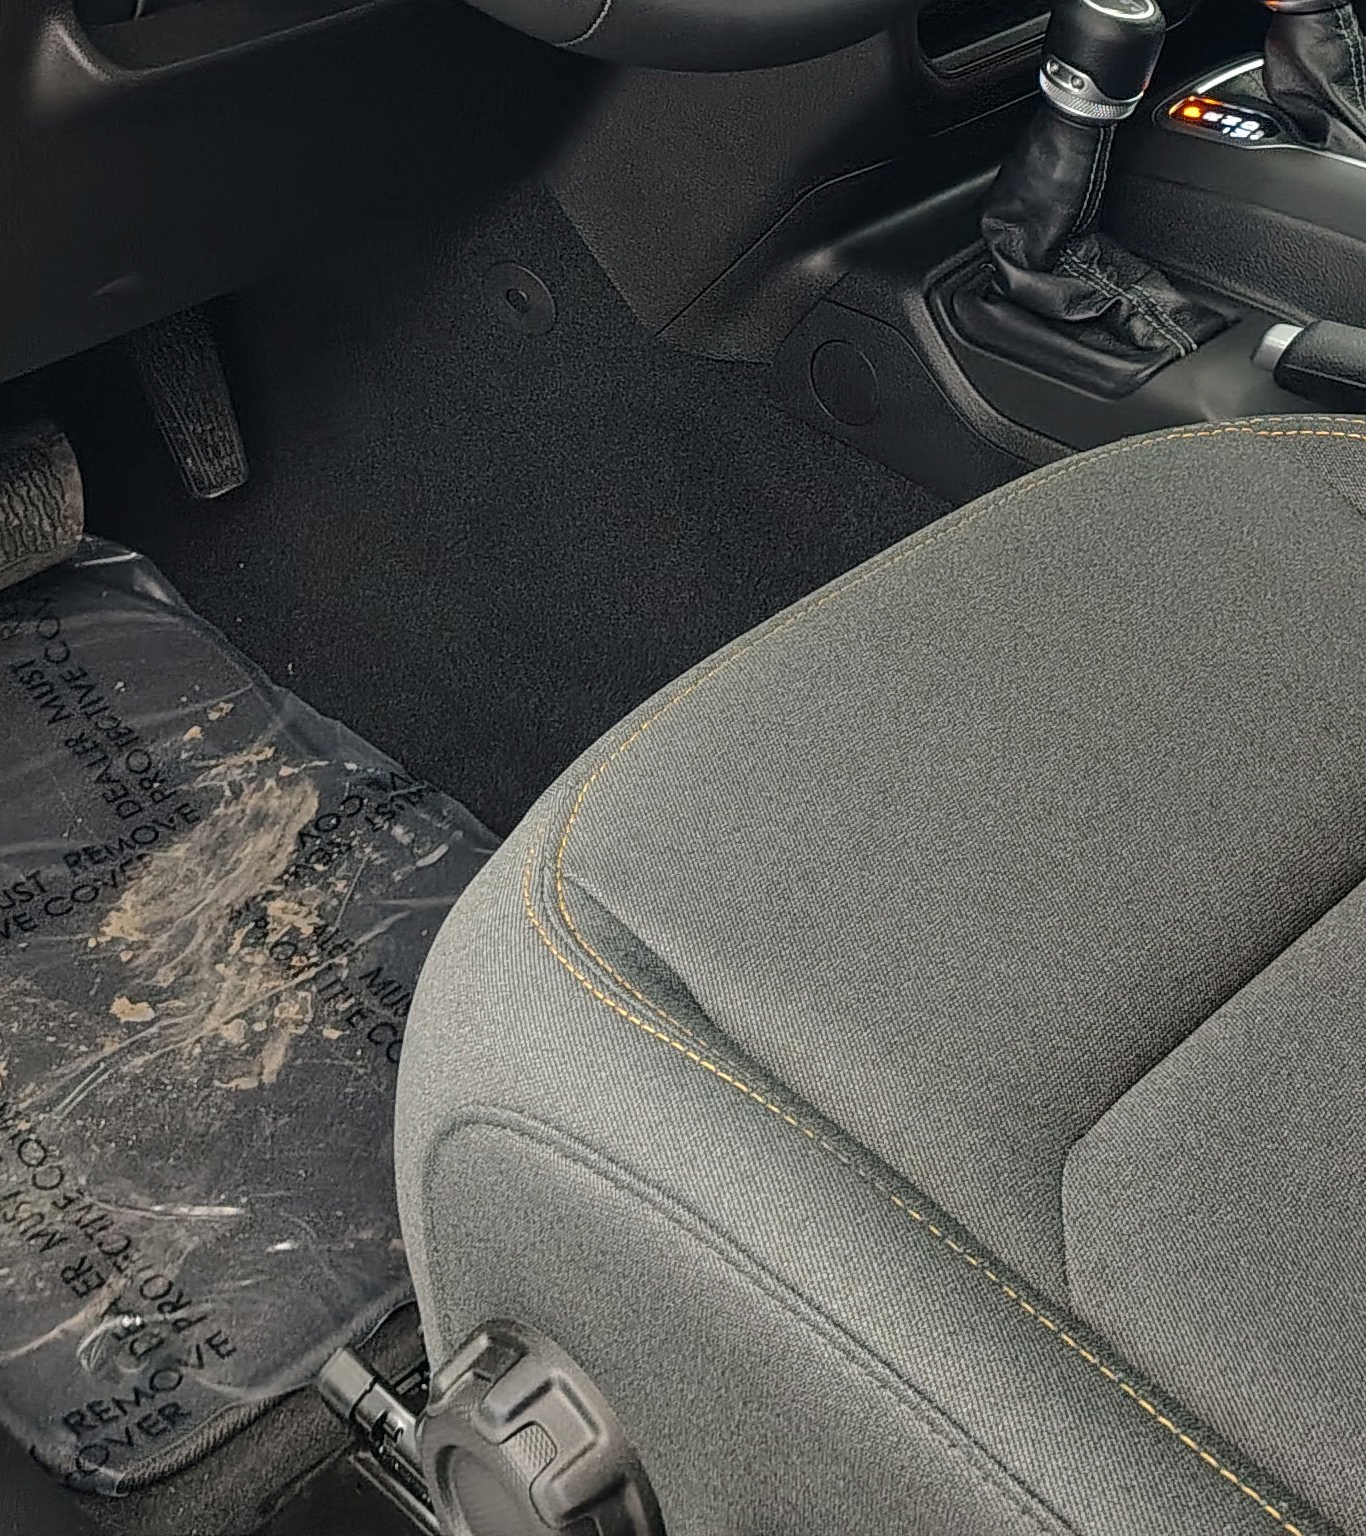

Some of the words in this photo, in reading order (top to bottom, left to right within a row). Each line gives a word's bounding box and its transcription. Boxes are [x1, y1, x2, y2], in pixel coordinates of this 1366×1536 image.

[9, 657, 75, 728] MUST
[64, 734, 143, 822] DEALER
[62, 803, 201, 877] REMOVE
[62, 1329, 238, 1437] REMOVE
